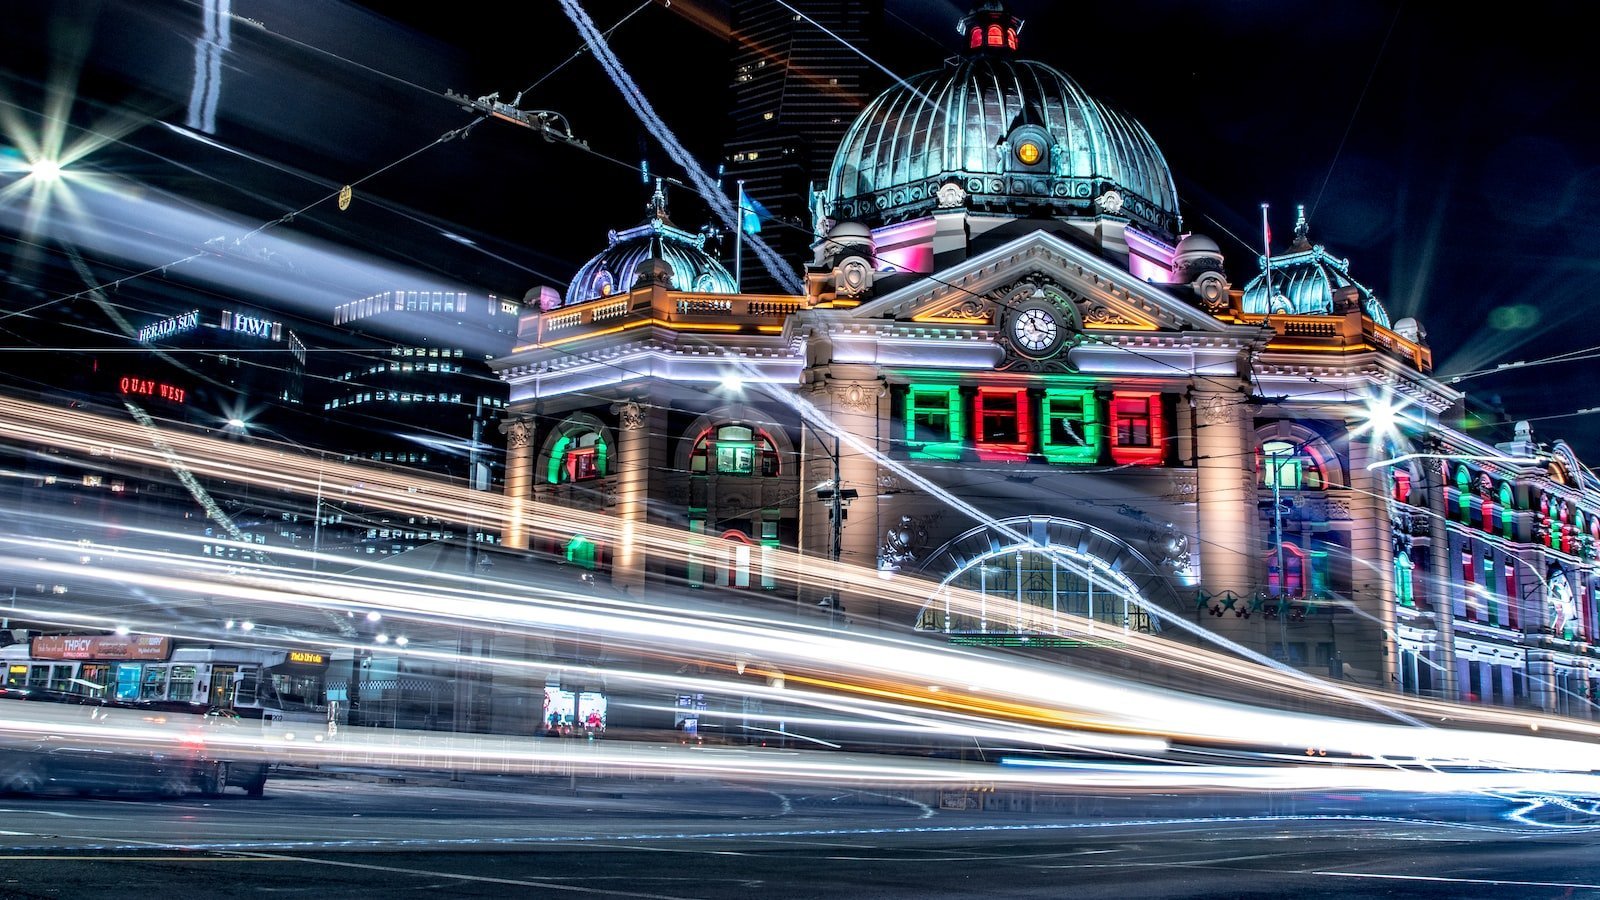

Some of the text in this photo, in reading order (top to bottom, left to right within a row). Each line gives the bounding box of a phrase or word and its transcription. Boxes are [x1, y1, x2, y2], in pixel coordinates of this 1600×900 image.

[501, 302, 518, 315] IBM
[139, 312, 199, 341] HERALD SUN
[235, 314, 272, 338] HWT
[121, 377, 185, 402] QUAY WEST
